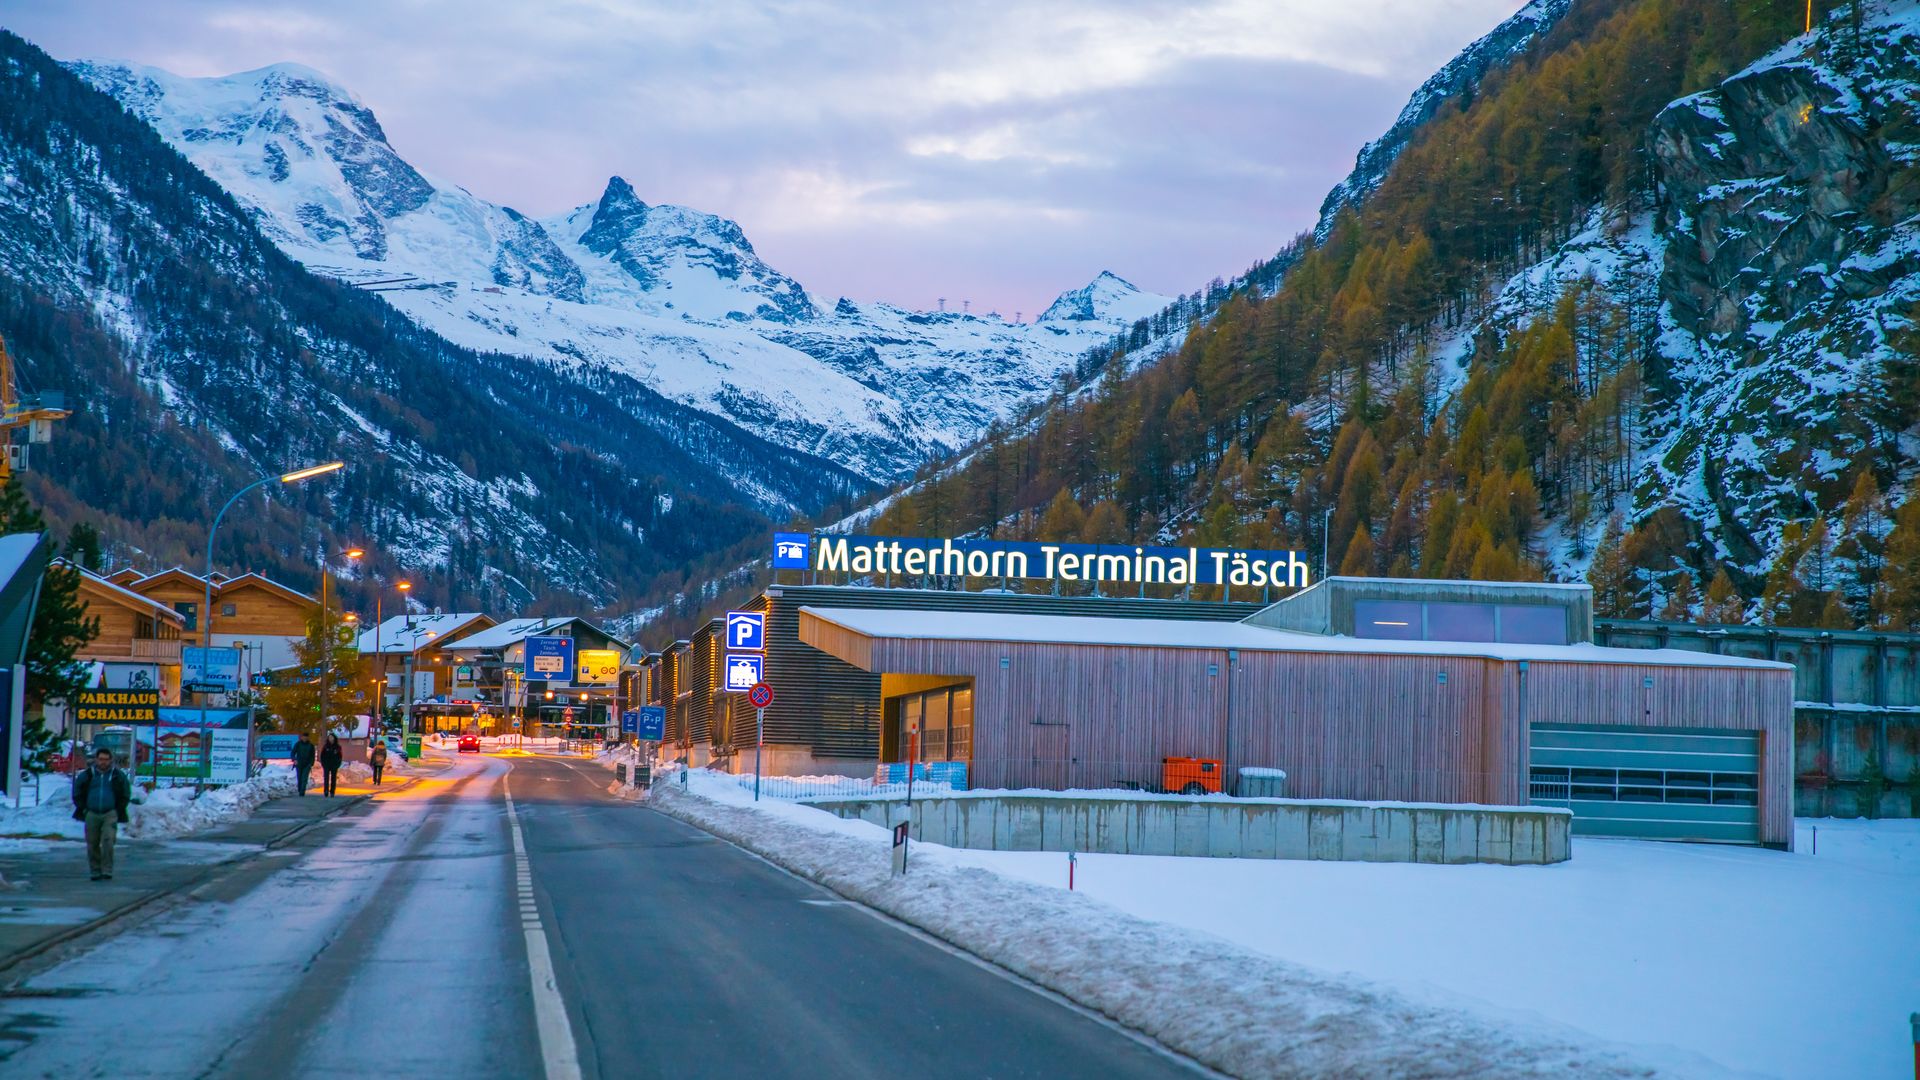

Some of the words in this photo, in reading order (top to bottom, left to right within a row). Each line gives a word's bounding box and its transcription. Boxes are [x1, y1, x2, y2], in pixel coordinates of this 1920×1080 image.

[778, 546, 788, 558] P
[817, 538, 1027, 578] Matterhorn
[1041, 546, 1196, 584] Terminal
[1210, 551, 1308, 588] Täsch
[736, 623, 753, 646] P
[192, 685, 224, 693] Talisman
[79, 693, 158, 705] PARKHAUS
[78, 709, 155, 720] SCHALLER
